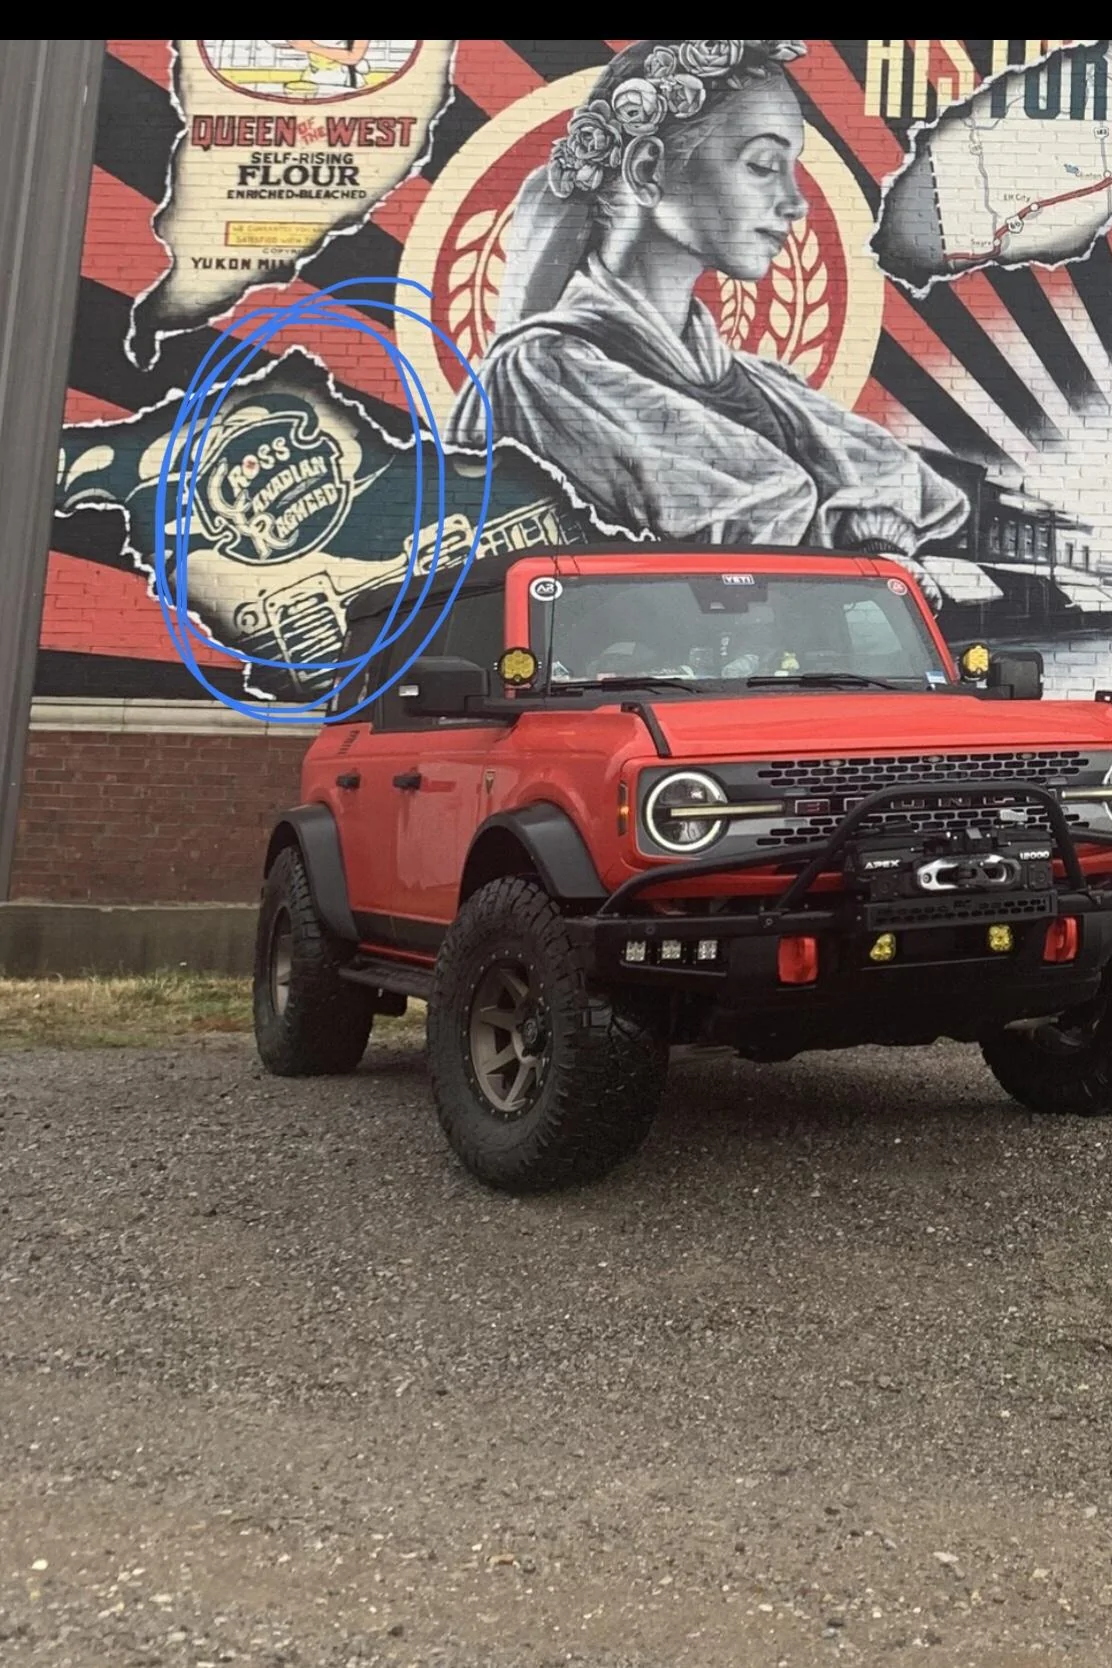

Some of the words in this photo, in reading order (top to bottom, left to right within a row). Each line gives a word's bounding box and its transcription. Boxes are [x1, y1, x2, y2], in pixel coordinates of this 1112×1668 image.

[191, 114, 298, 151] QUEEN
[298, 116, 315, 136] OF
[302, 125, 327, 146] THE
[325, 116, 418, 148] WEST
[250, 151, 355, 165] SELF-RISING
[237, 164, 361, 187] FLOUR
[226, 188, 368, 200] ENRICHED-BLEACHED
[191, 257, 251, 270] YUKON
